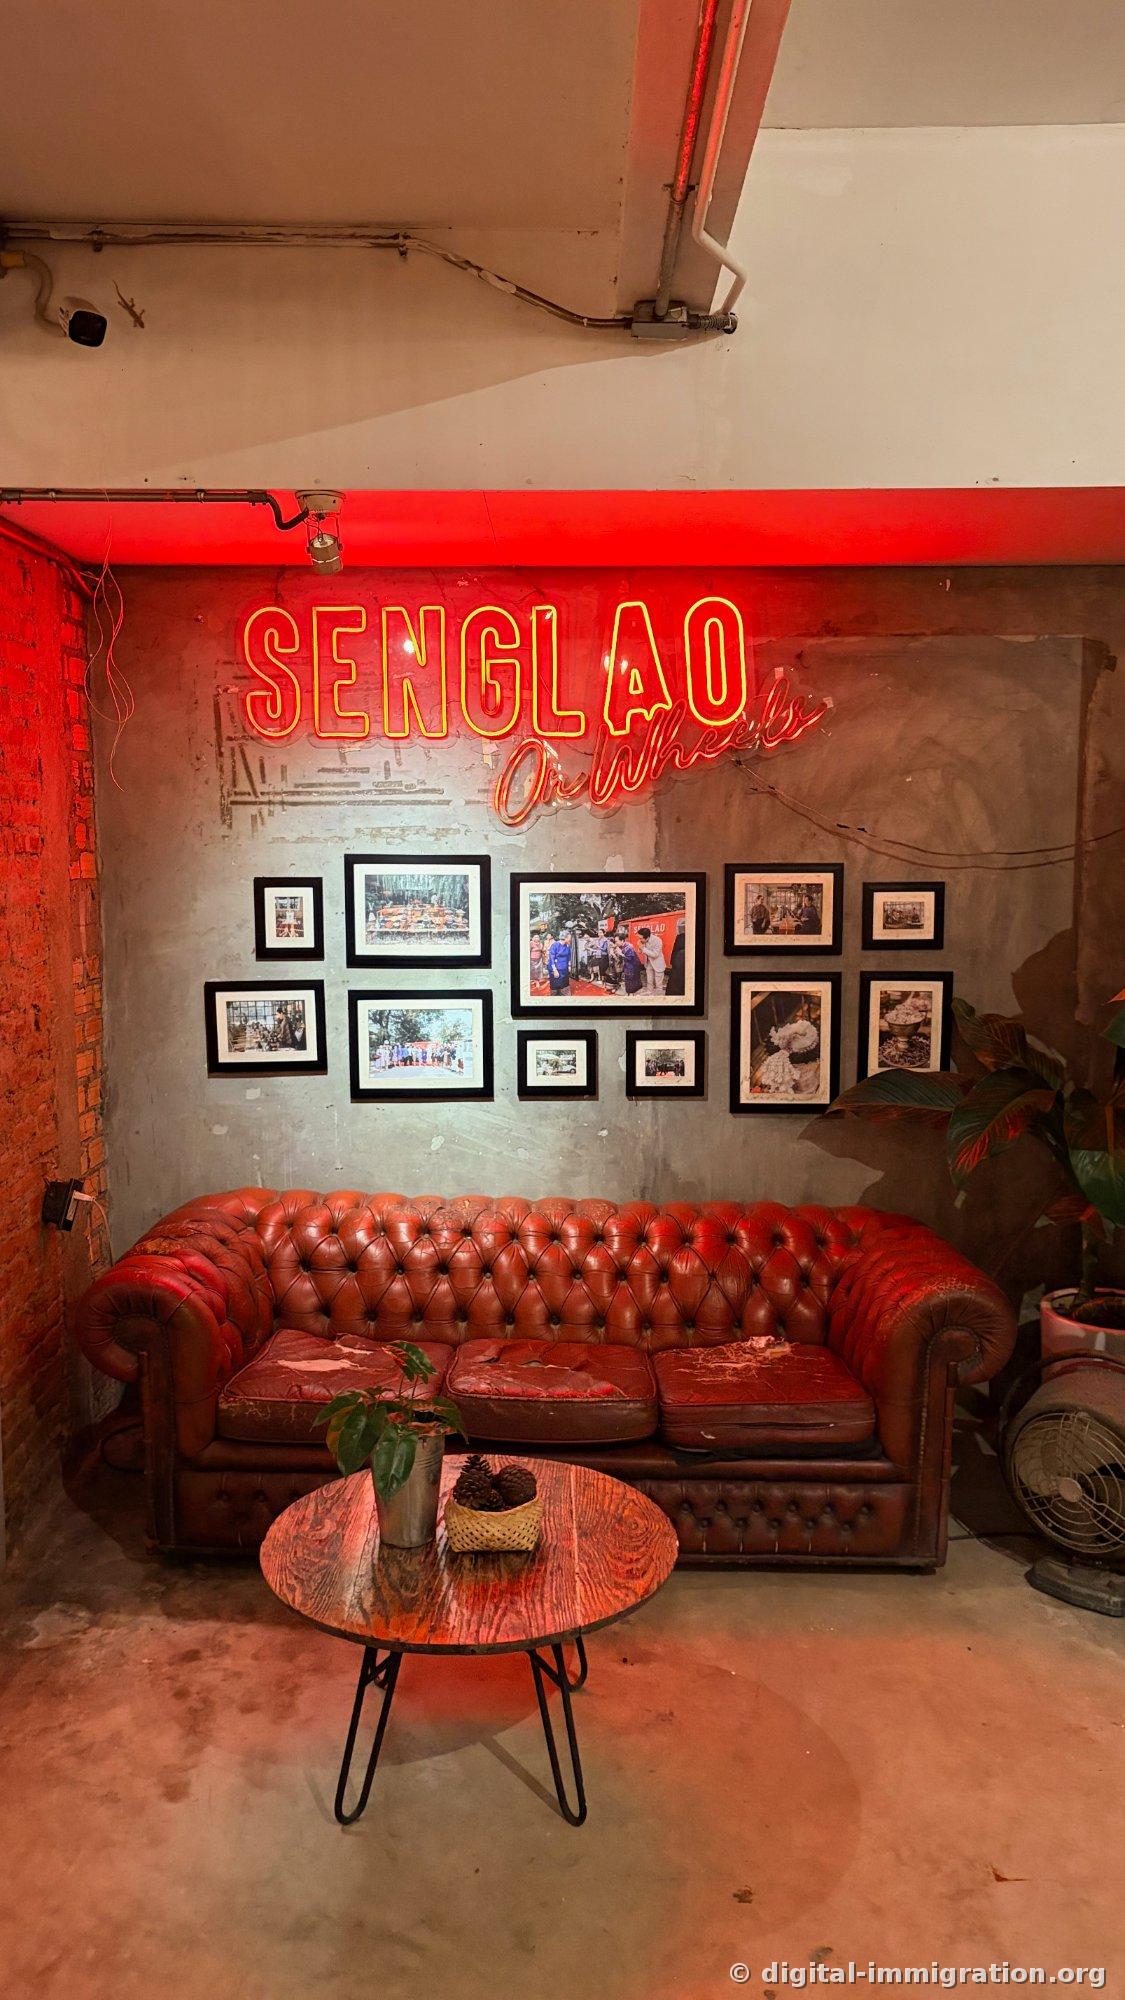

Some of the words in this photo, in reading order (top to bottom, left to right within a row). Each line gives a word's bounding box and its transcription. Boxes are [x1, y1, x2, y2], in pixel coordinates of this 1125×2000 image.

[243, 596, 747, 739] SENGLAO
[493, 738, 589, 826] On
[588, 677, 830, 806] Wheels
